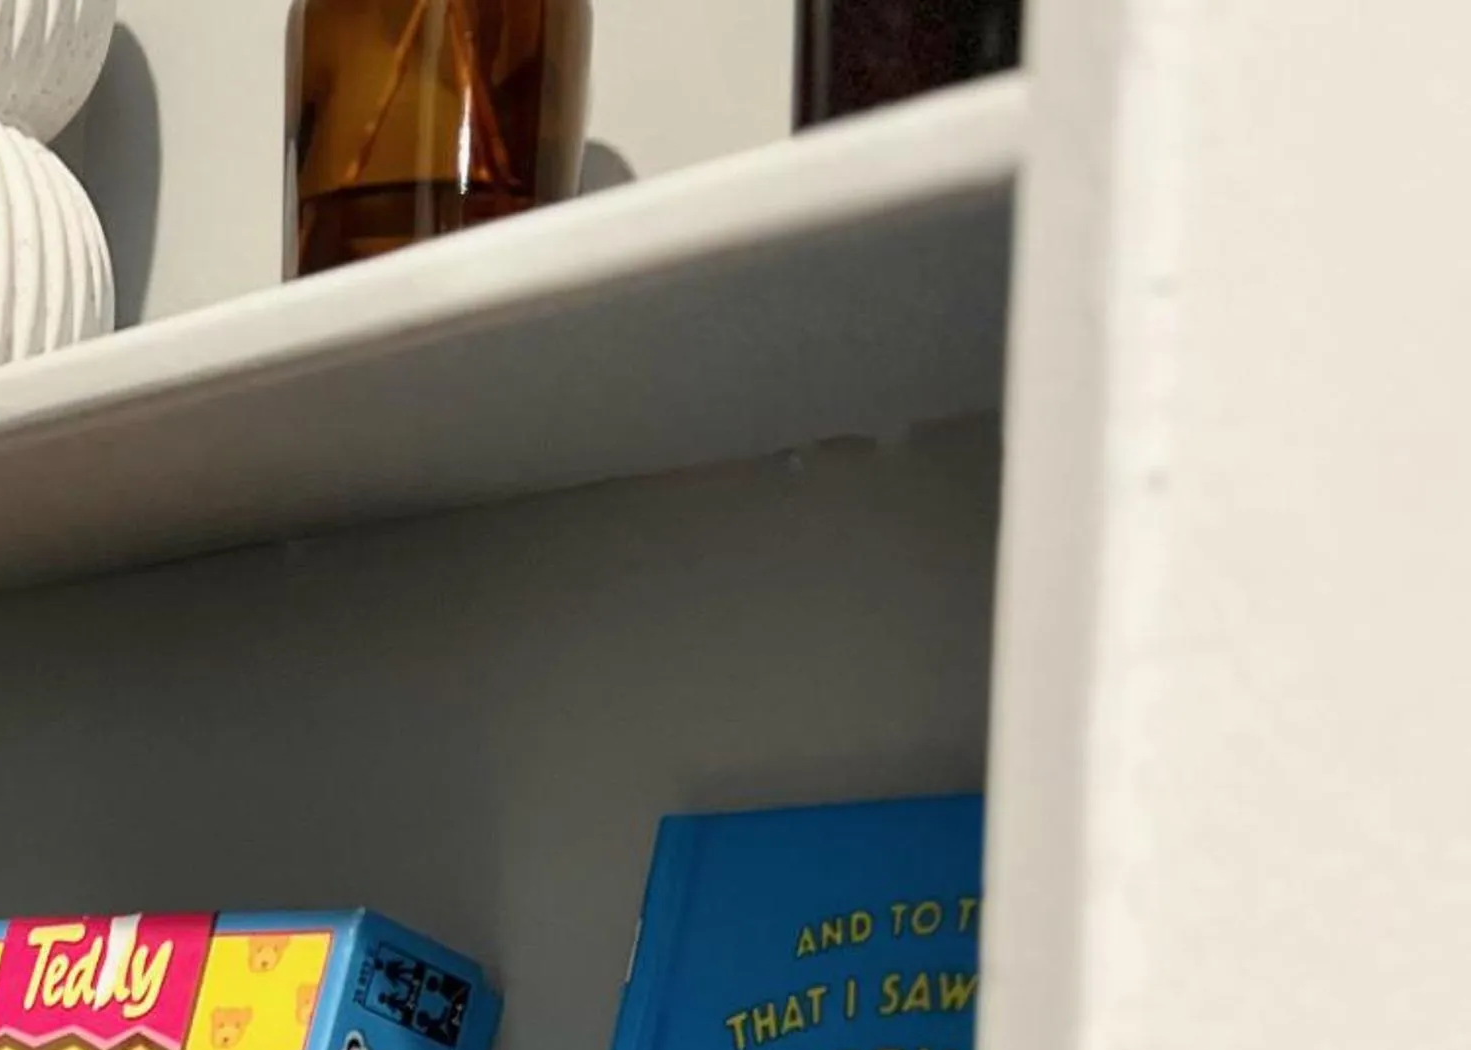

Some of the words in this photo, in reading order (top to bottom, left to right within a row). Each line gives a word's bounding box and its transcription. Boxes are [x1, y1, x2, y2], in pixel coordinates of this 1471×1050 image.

[796, 910, 873, 957] AND
[891, 901, 942, 937] TO
[23, 920, 172, 1015] Teddy
[845, 979, 857, 1018] I
[879, 972, 980, 1016] SAW
